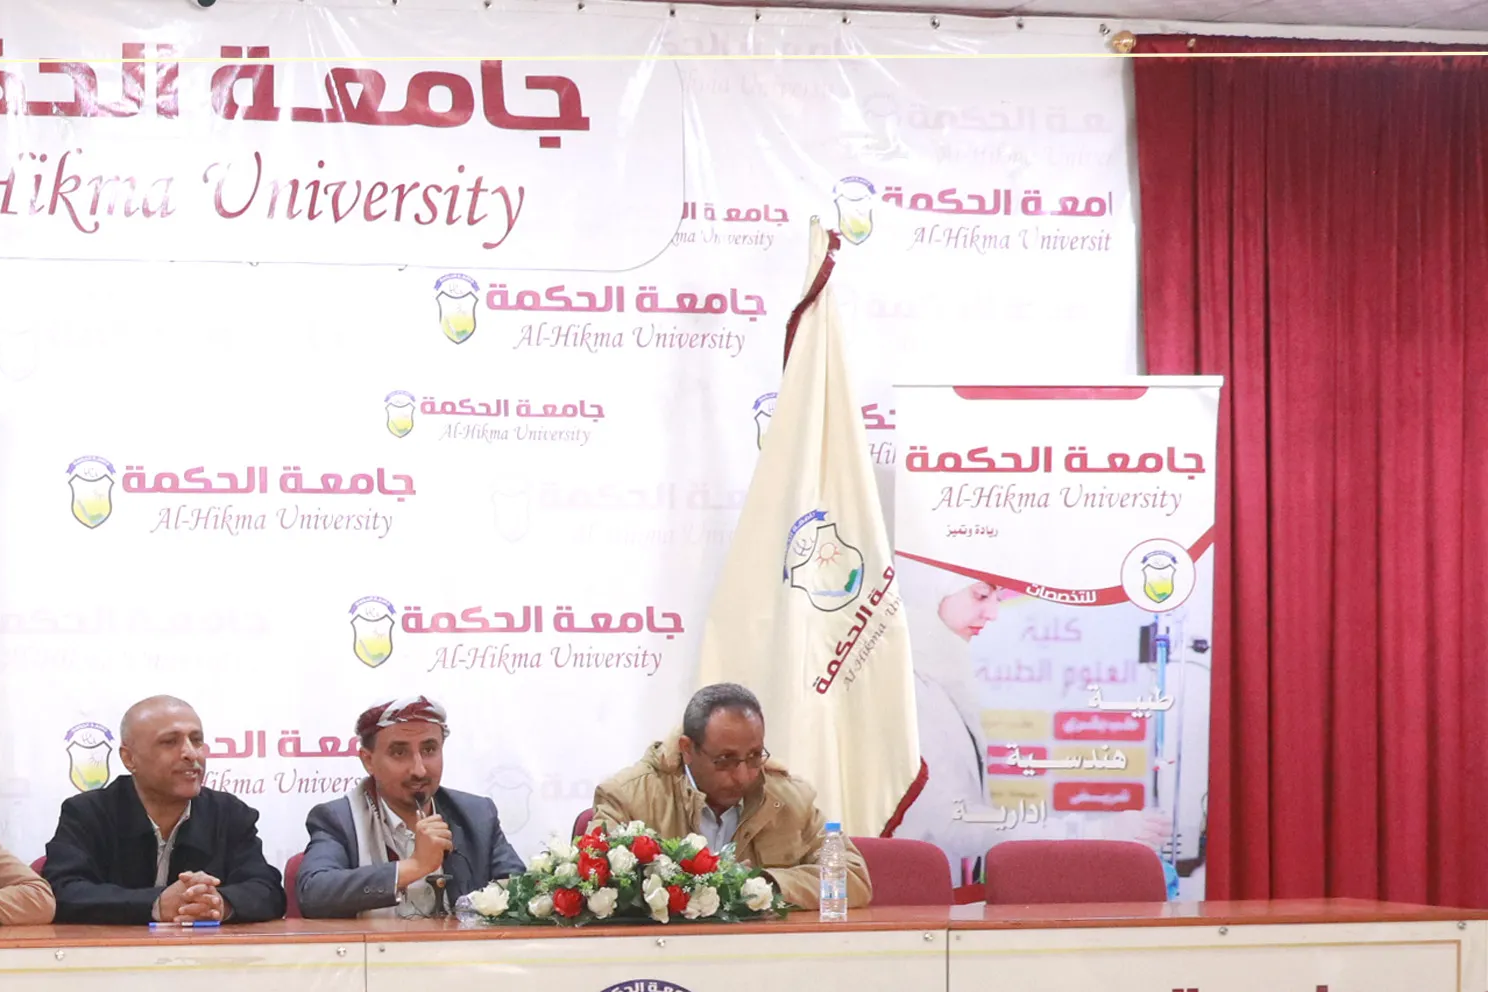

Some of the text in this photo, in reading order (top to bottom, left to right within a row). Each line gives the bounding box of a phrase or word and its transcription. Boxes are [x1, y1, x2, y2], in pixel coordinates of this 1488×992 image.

[211, 46, 590, 149] جامعة
[203, 151, 526, 249] University
[704, 202, 789, 227] جامعة
[881, 186, 1112, 217] معة الحكمة
[701, 227, 774, 251] Unversity
[906, 224, 1112, 256] Al-Hikma Universit
[486, 283, 767, 322] جامعة الحكمة
[512, 322, 745, 358] Al-Hikma University
[420, 397, 605, 422] جامعة الحكمة
[439, 422, 591, 446] Al-Hikma University
[905, 445, 1052, 474] الحكمة
[1064, 446, 1206, 480] جامعة
[122, 465, 416, 502] جامعة الحكمة
[932, 484, 1183, 516] Al-Hikma University
[150, 504, 392, 539] Al-Hikma University
[946, 524, 999, 538] ريادة وتميز
[1025, 582, 1097, 605] للتخصصات
[401, 605, 684, 640] جامعة الحكمة
[427, 643, 663, 676] Al-Hikma University
[812, 605, 873, 694] الحكمة
[1086, 684, 1176, 718] طبية
[278, 730, 362, 757] معة
[1006, 743, 1128, 777] هندسية
[274, 772, 361, 795] Univers
